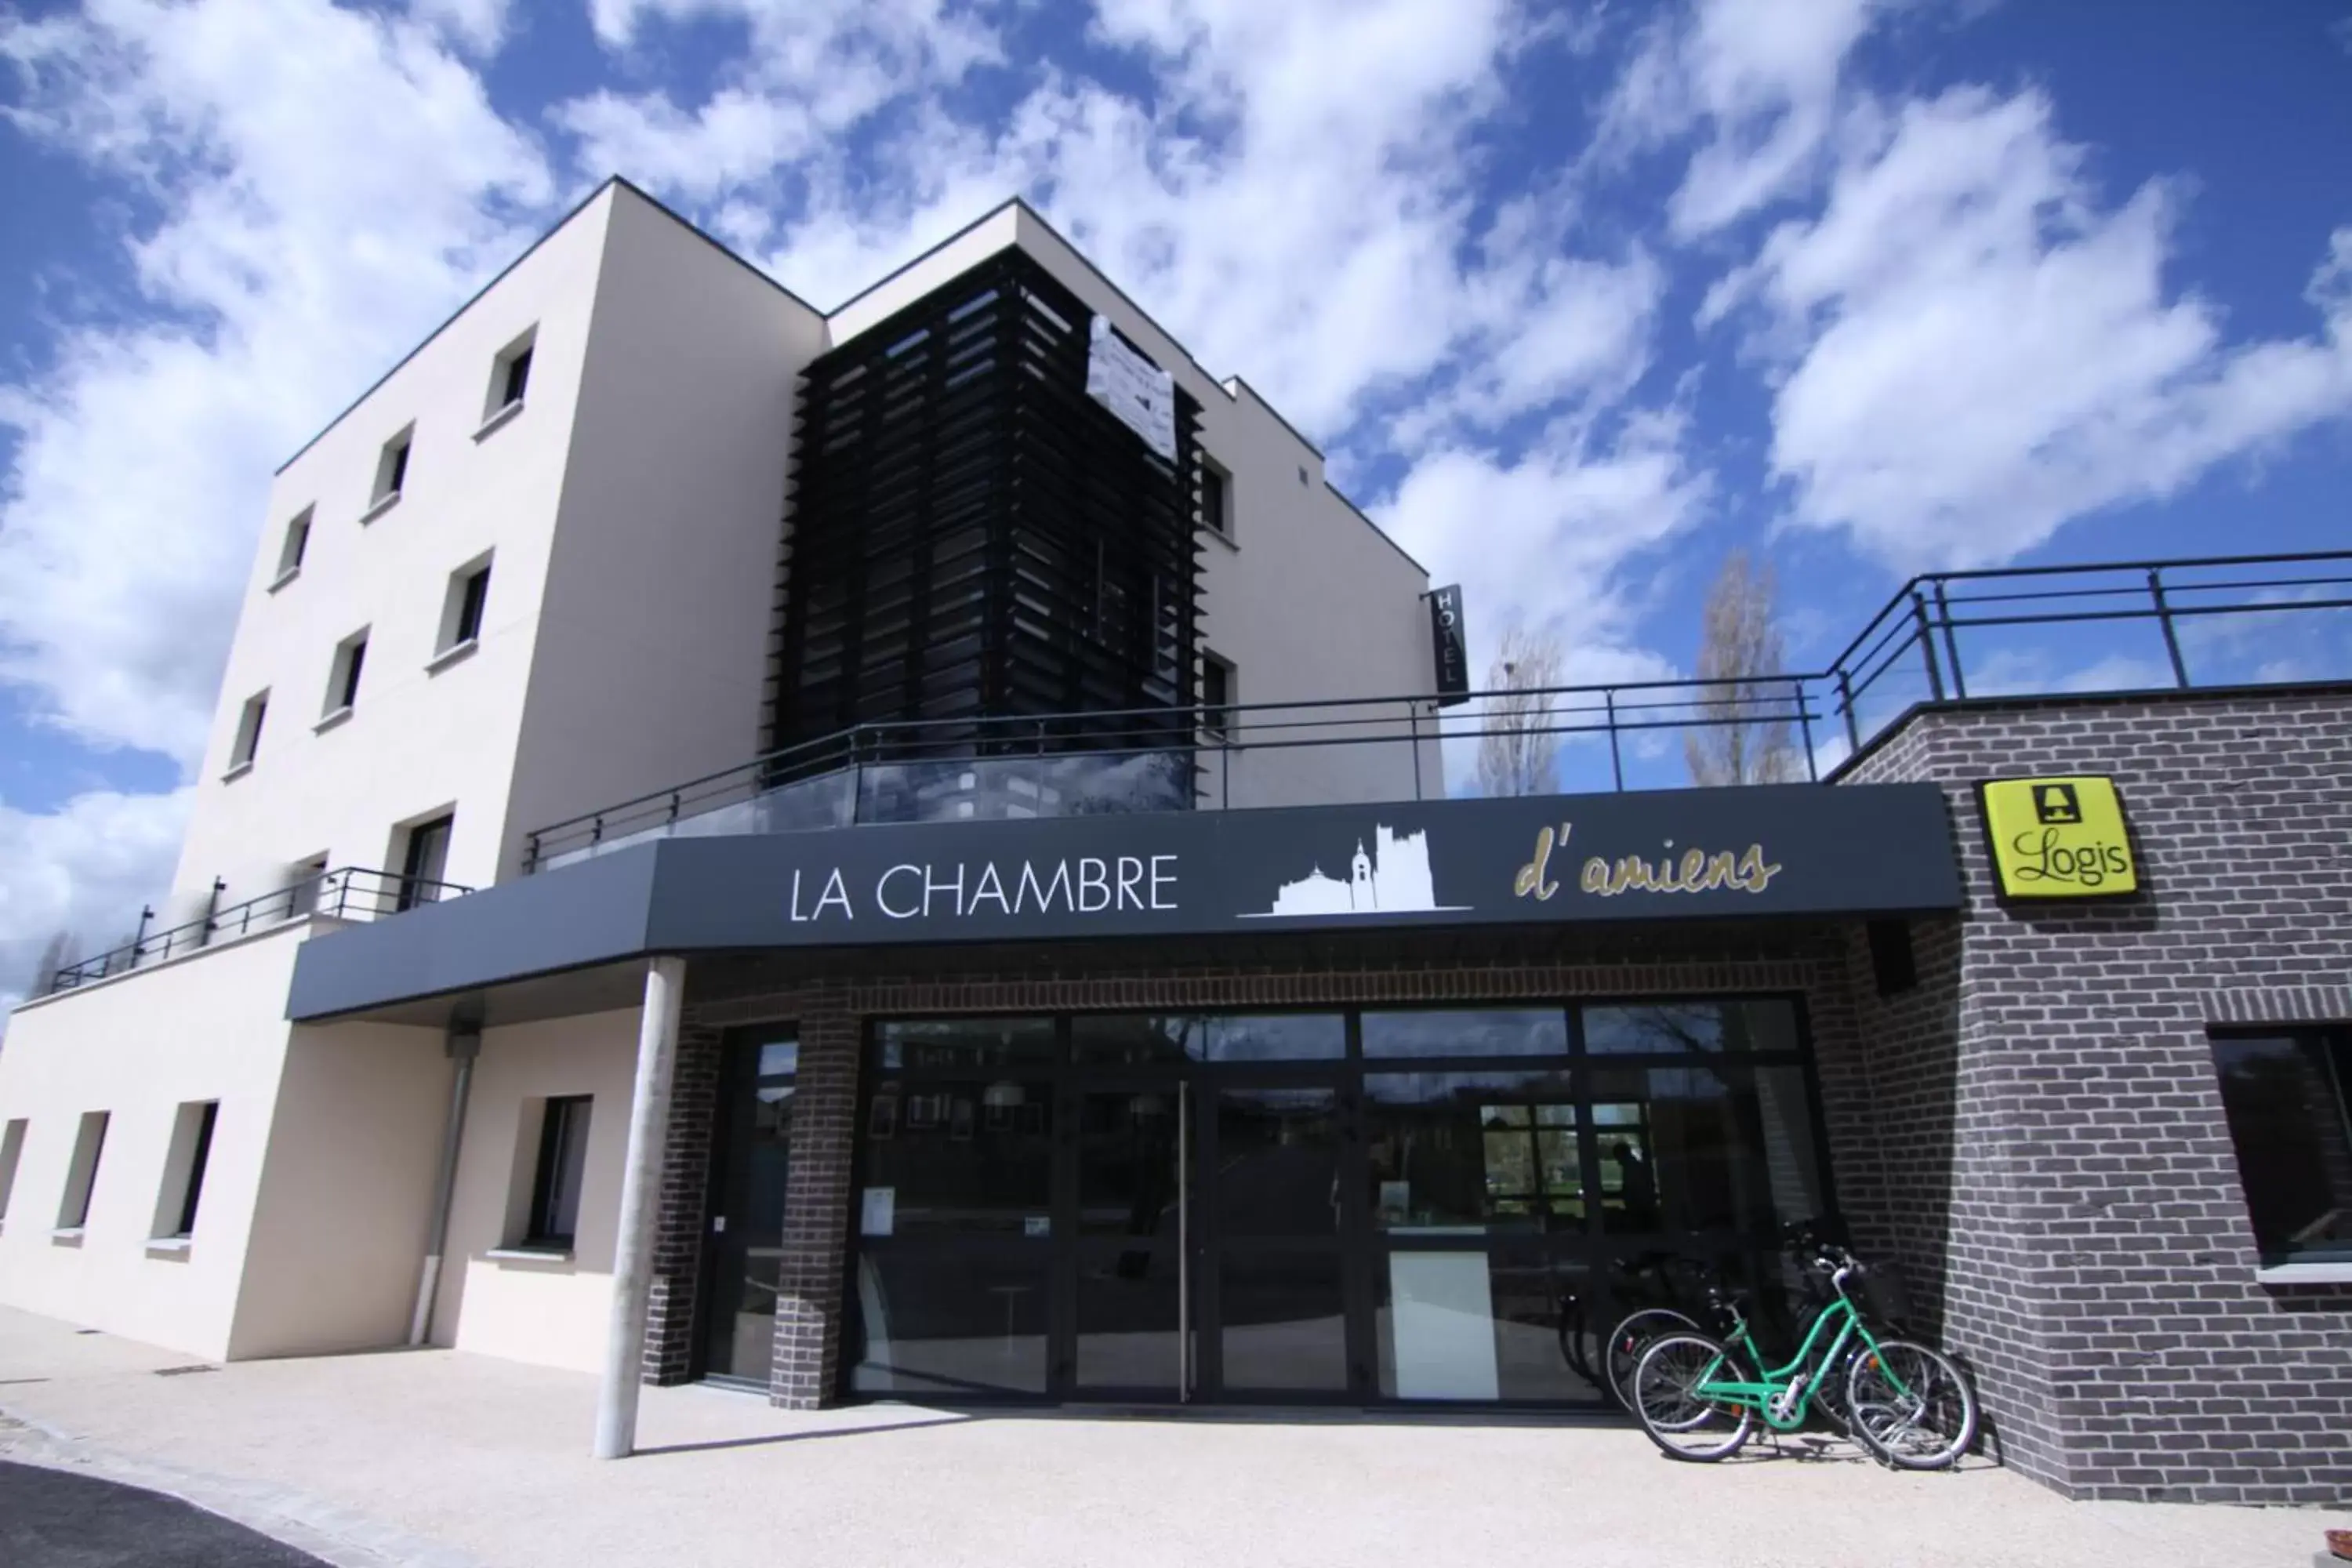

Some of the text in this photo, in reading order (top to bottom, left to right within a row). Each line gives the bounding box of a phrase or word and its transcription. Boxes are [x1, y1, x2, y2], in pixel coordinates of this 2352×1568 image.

[1438, 592, 1457, 683] HOTEL
[790, 867, 854, 921] LA
[876, 855, 1178, 918] CHAMBRE
[2013, 827, 2128, 887] Logis
